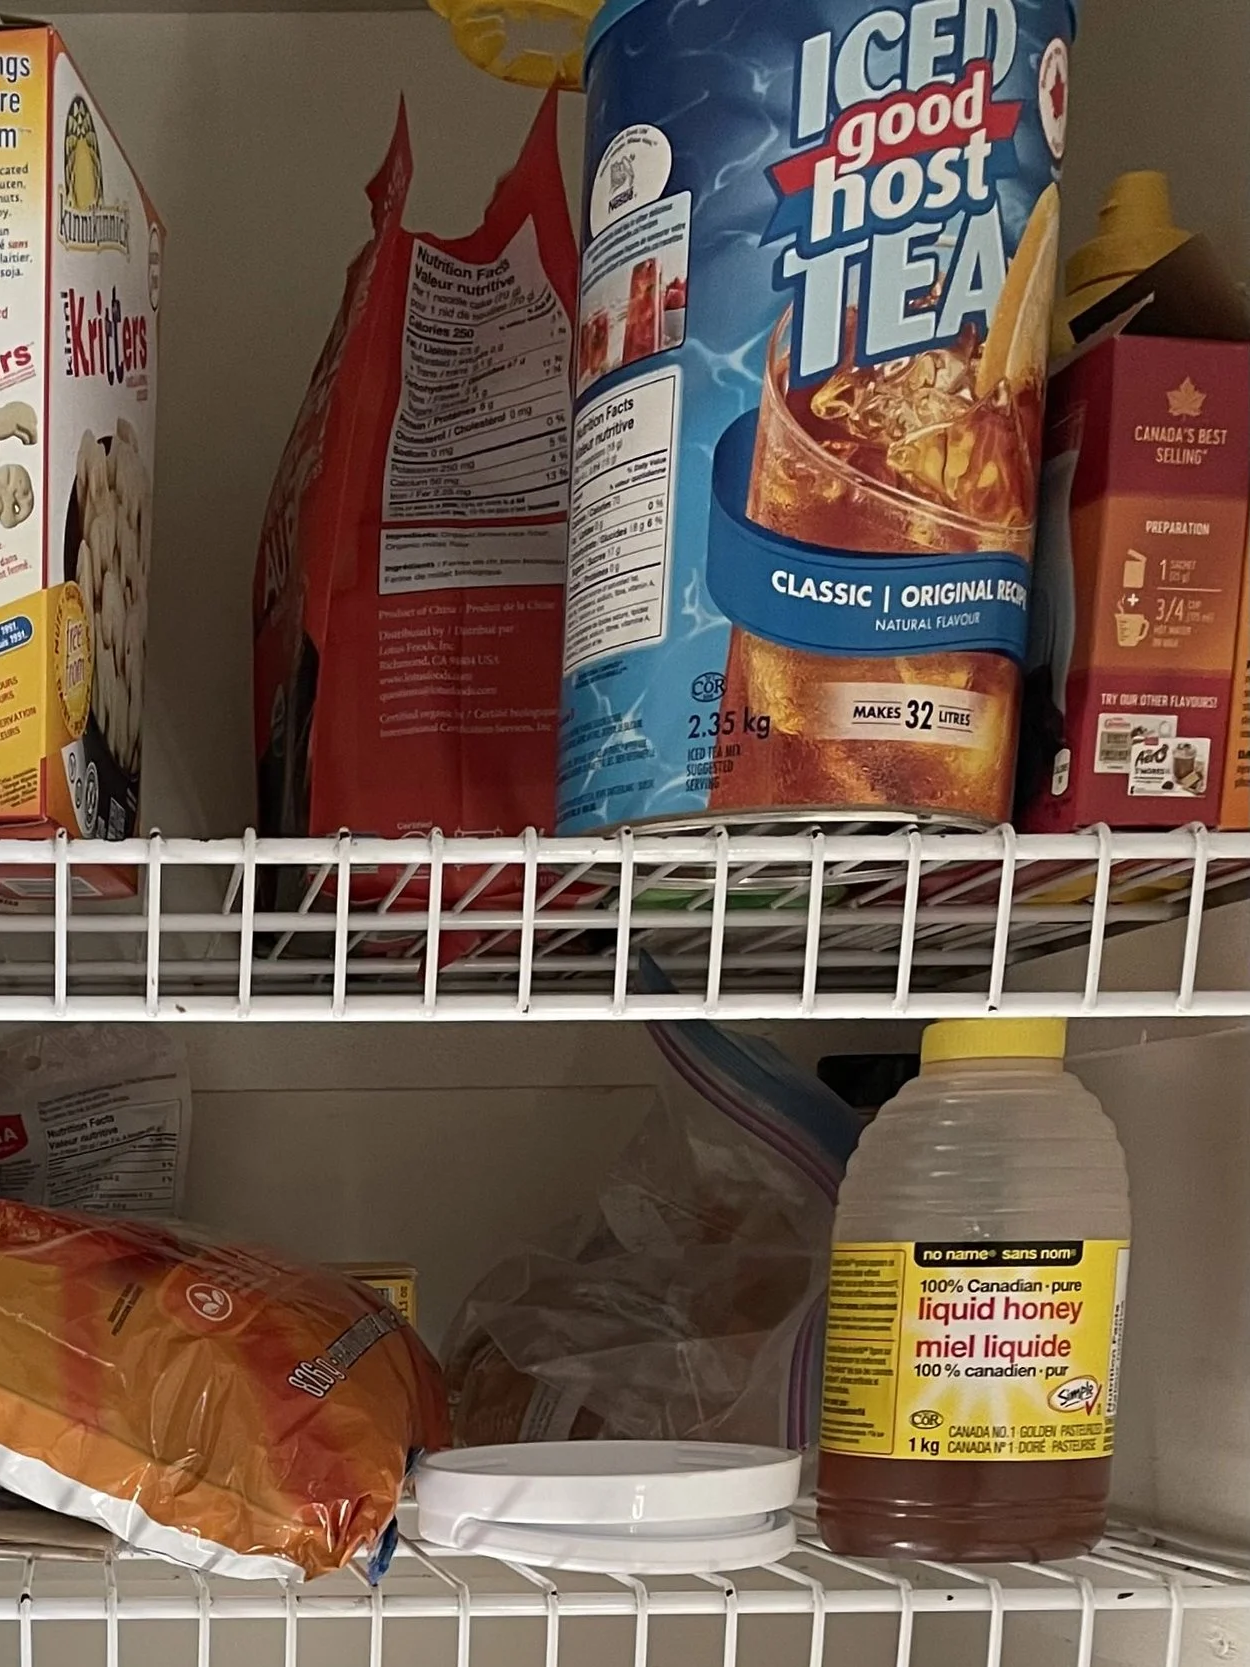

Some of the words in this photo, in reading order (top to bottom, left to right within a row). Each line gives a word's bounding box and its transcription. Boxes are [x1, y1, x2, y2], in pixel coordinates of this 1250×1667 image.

[797, 0, 1016, 140] ICED
[837, 71, 985, 169] good
[811, 133, 992, 243] host
[417, 246, 472, 281] Nutrition
[784, 202, 1008, 376] TEA
[68, 285, 147, 386] Kritters
[1135, 426, 1195, 443] CANADA'S
[1199, 428, 1227, 445] BEST
[1146, 521, 1210, 536] PREPARATION
[771, 570, 872, 608] CLASSIC
[901, 579, 993, 609] ORIGINAL
[875, 617, 932, 632] NATURAL
[936, 612, 980, 630] FLAVOUR
[1155, 598, 1184, 622] 3/4
[688, 711, 735, 740] 2.35
[742, 710, 771, 740] kg
[853, 702, 901, 721] MAKES
[904, 700, 934, 730] 32
[938, 710, 971, 727] LITRES
[47, 1123, 87, 1139] Nutrition
[89, 1114, 115, 1128] Facts
[923, 1250, 942, 1260] no
[946, 1250, 988, 1260] name
[1002, 1250, 1036, 1259] sans
[1040, 1249, 1071, 1259] nom
[920, 1280, 964, 1293] 100%
[967, 1279, 1043, 1293] Canadian
[1051, 1280, 1082, 1295] pure
[918, 1297, 995, 1325] liquid
[1004, 1297, 1083, 1324] honey
[915, 1335, 976, 1358] miel
[984, 1335, 1071, 1363] liquide
[914, 1364, 942, 1377] 100
[945, 1364, 961, 1377] %
[965, 1364, 1036, 1377] canadien
[1045, 1365, 1068, 1379] pur
[1058, 1383, 1095, 1405] Simple
[908, 1438, 915, 1452] 1
[919, 1437, 940, 1455] kg
